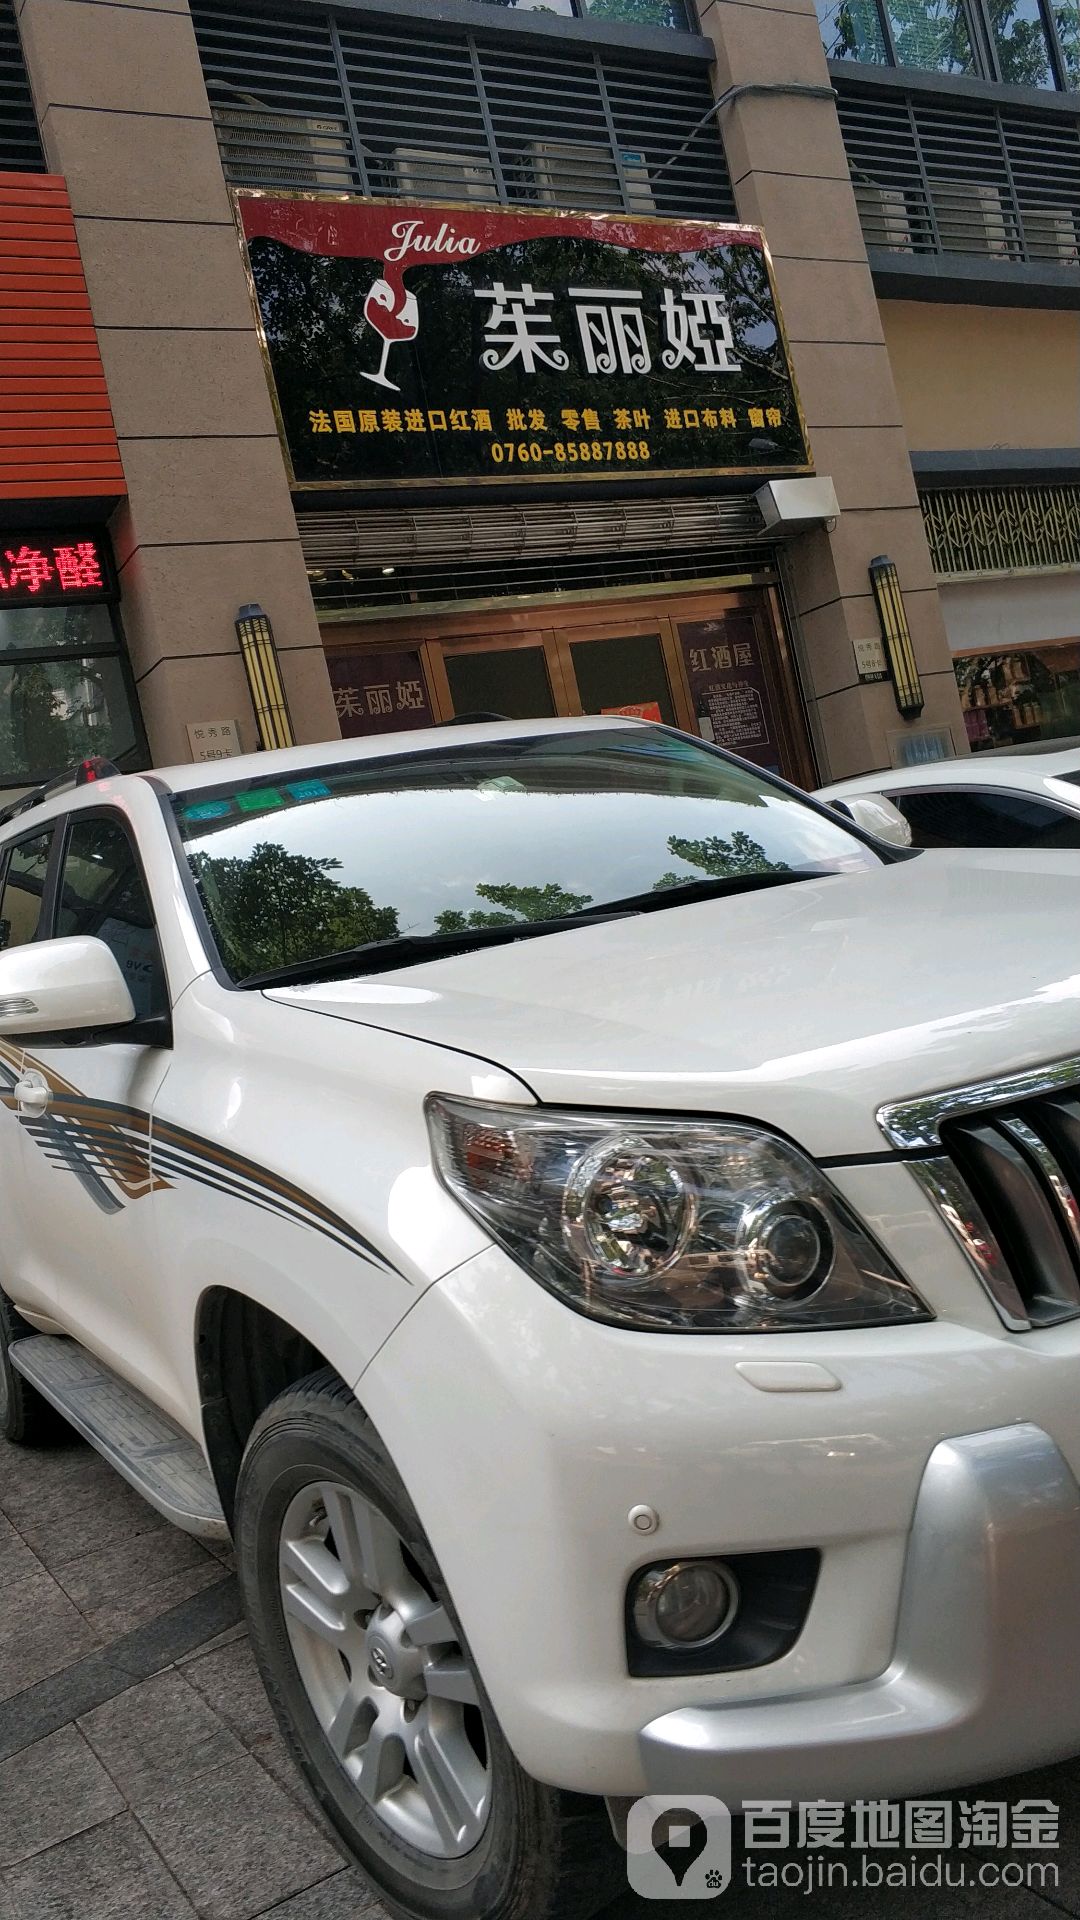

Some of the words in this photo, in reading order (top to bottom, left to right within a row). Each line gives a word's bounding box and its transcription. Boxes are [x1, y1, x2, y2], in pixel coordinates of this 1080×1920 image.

[383, 220, 481, 262] Julia
[308, 408, 493, 433] 法国原装进口红酒
[506, 408, 548, 431] 批发
[561, 408, 601, 431] 零售
[613, 408, 651, 430] 茶叶
[663, 407, 737, 429] 进口布料
[748, 407, 782, 428] 窗帘
[491, 441, 651, 463] 0760-85887888
[0, 542, 104, 592] 净醛
[689, 642, 755, 673] 红酒屋
